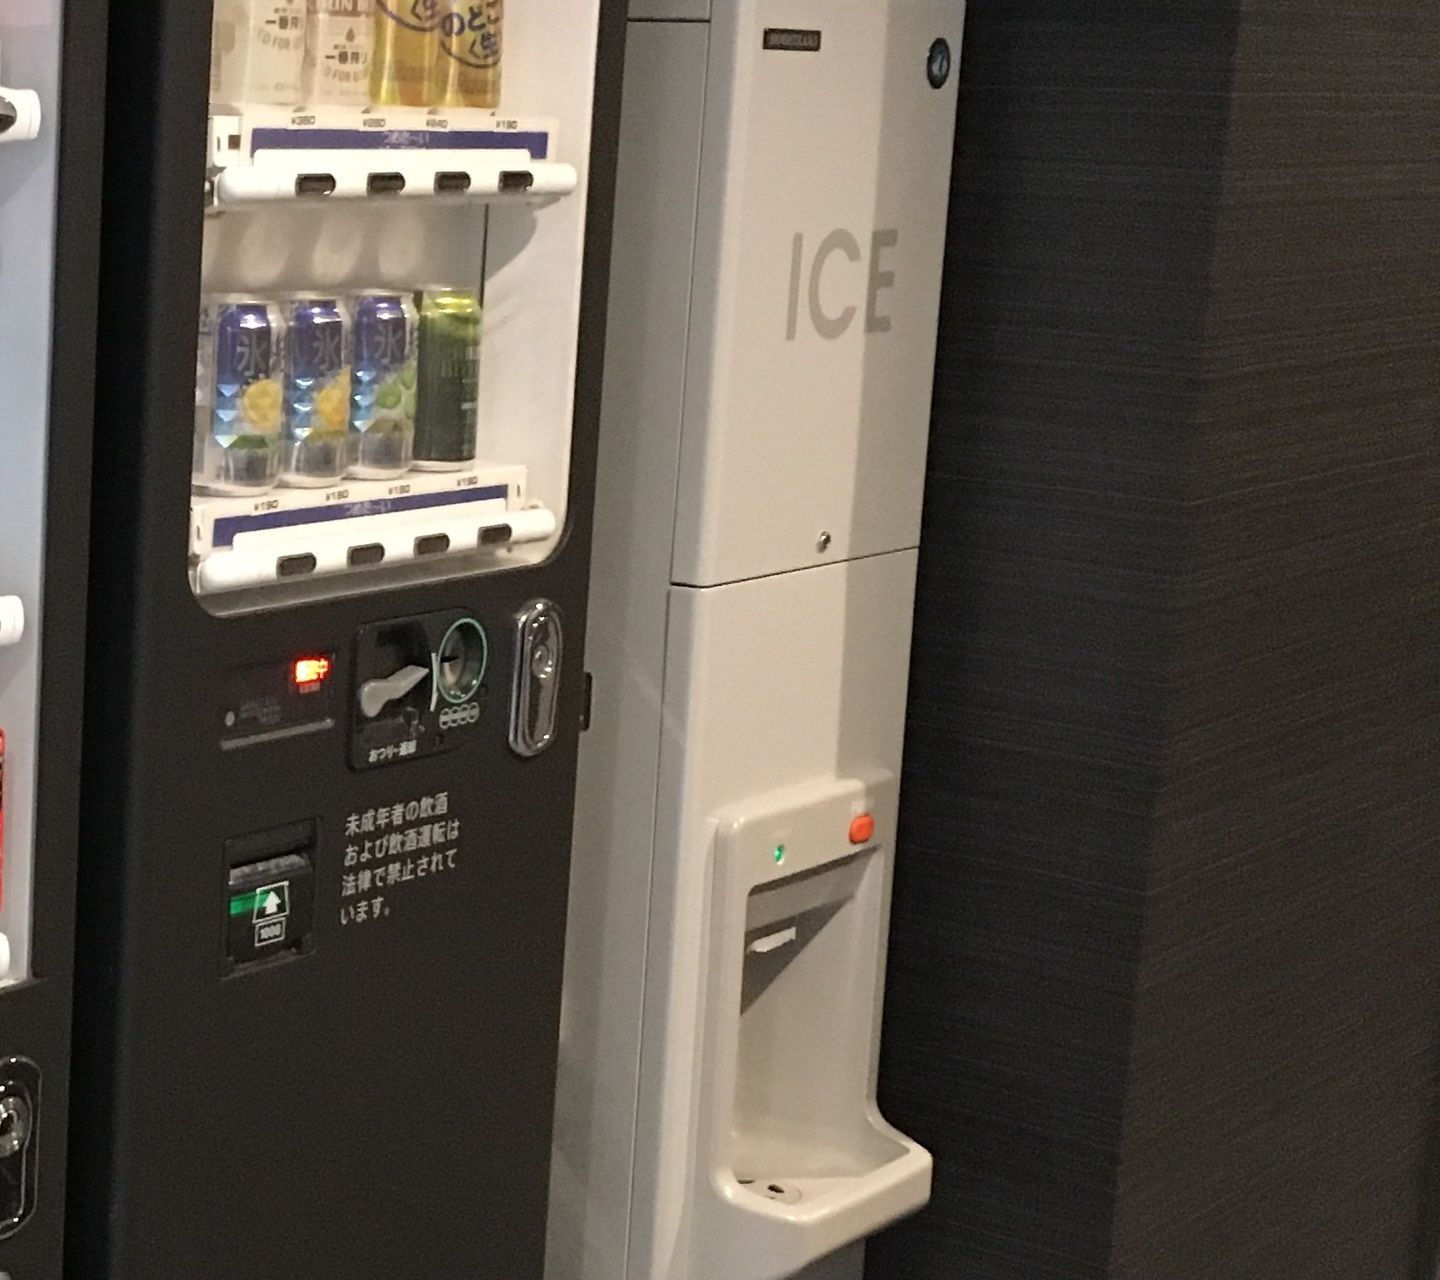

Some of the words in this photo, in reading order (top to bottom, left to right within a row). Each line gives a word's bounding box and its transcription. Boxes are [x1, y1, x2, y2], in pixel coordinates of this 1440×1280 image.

[785, 228, 898, 341] ICE
[345, 792, 448, 836] 未成年者の飲酒
[344, 819, 460, 867] および飲酒運転は
[341, 848, 458, 897] 法律で禁止されて
[340, 897, 389, 925] います。
